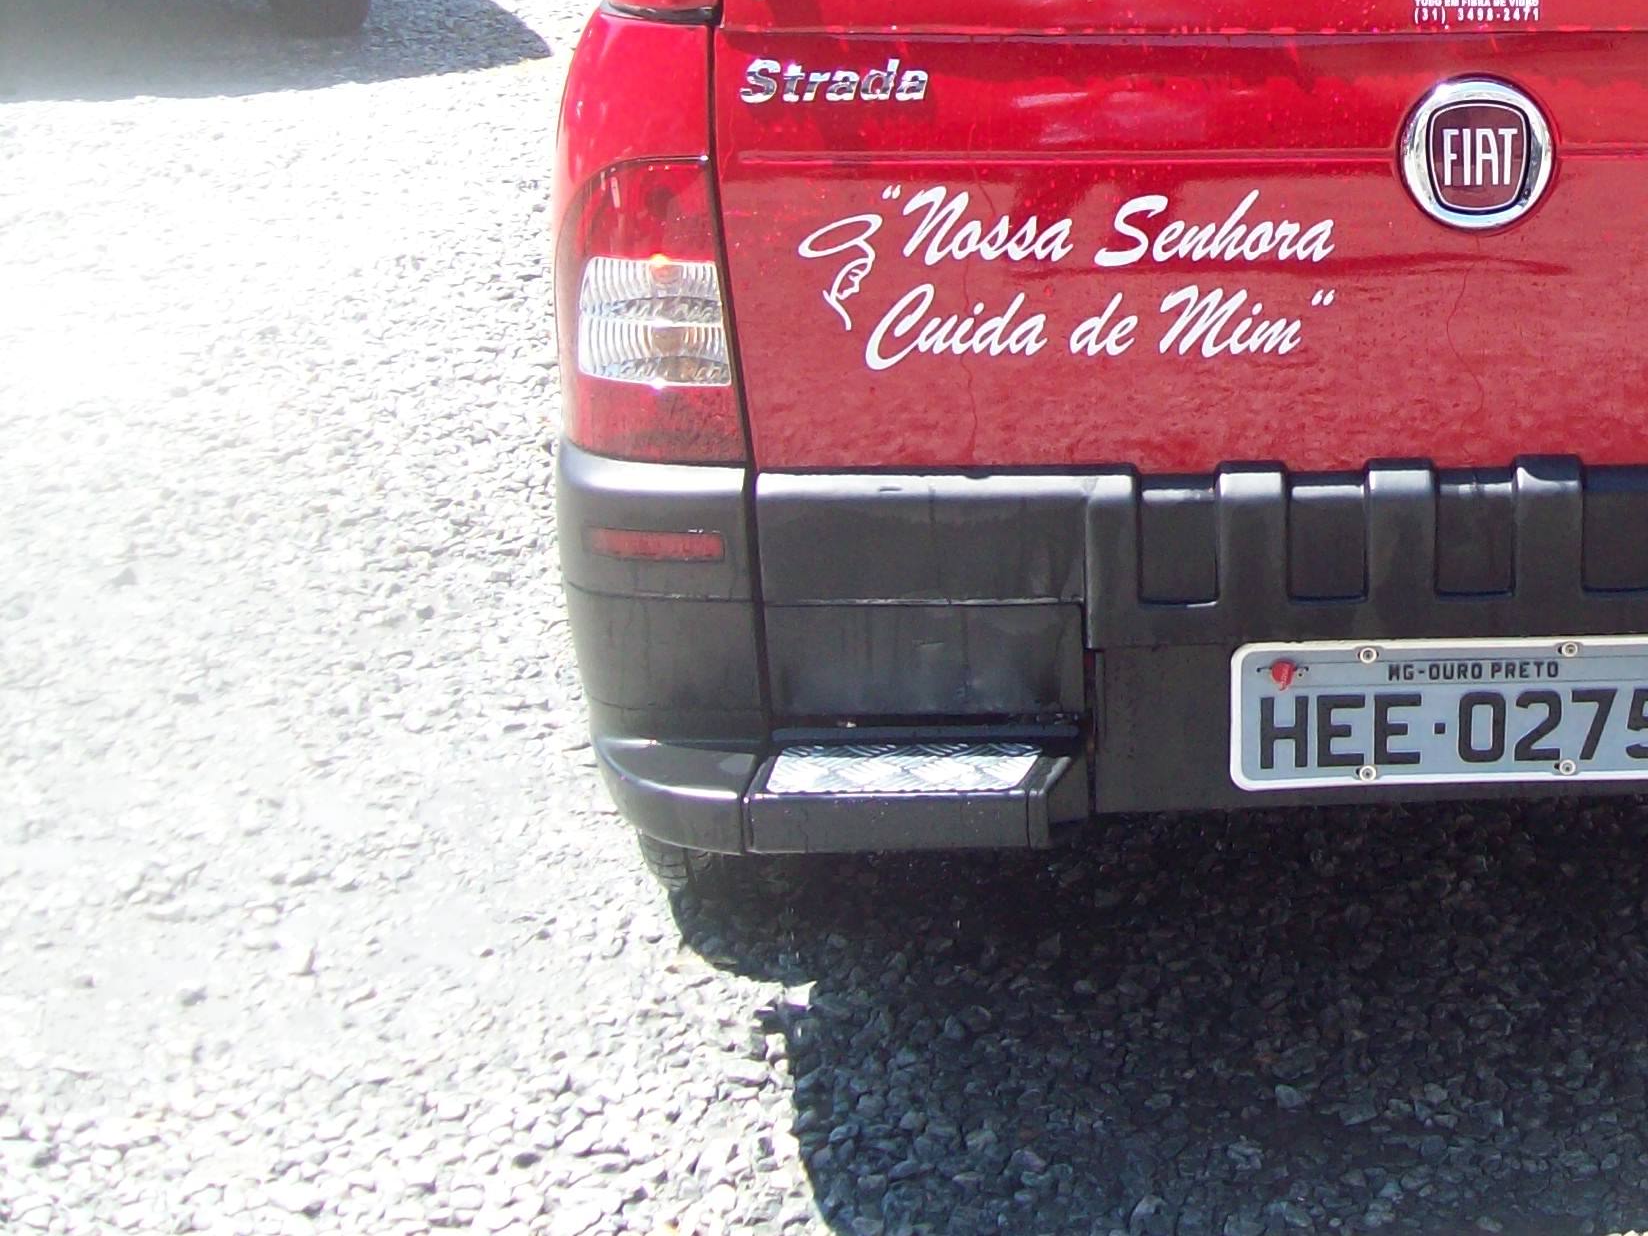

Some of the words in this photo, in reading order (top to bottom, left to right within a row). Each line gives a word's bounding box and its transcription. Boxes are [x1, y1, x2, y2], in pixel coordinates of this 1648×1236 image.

[1414, 6, 1446, 24] (31)
[739, 57, 928, 104] Strada
[1442, 128, 1519, 186] FIAT
[1094, 189, 1335, 267] Senhora
[864, 283, 1047, 370] Cuida
[1069, 292, 1138, 357] de
[1490, 660, 1560, 680] PRETO
